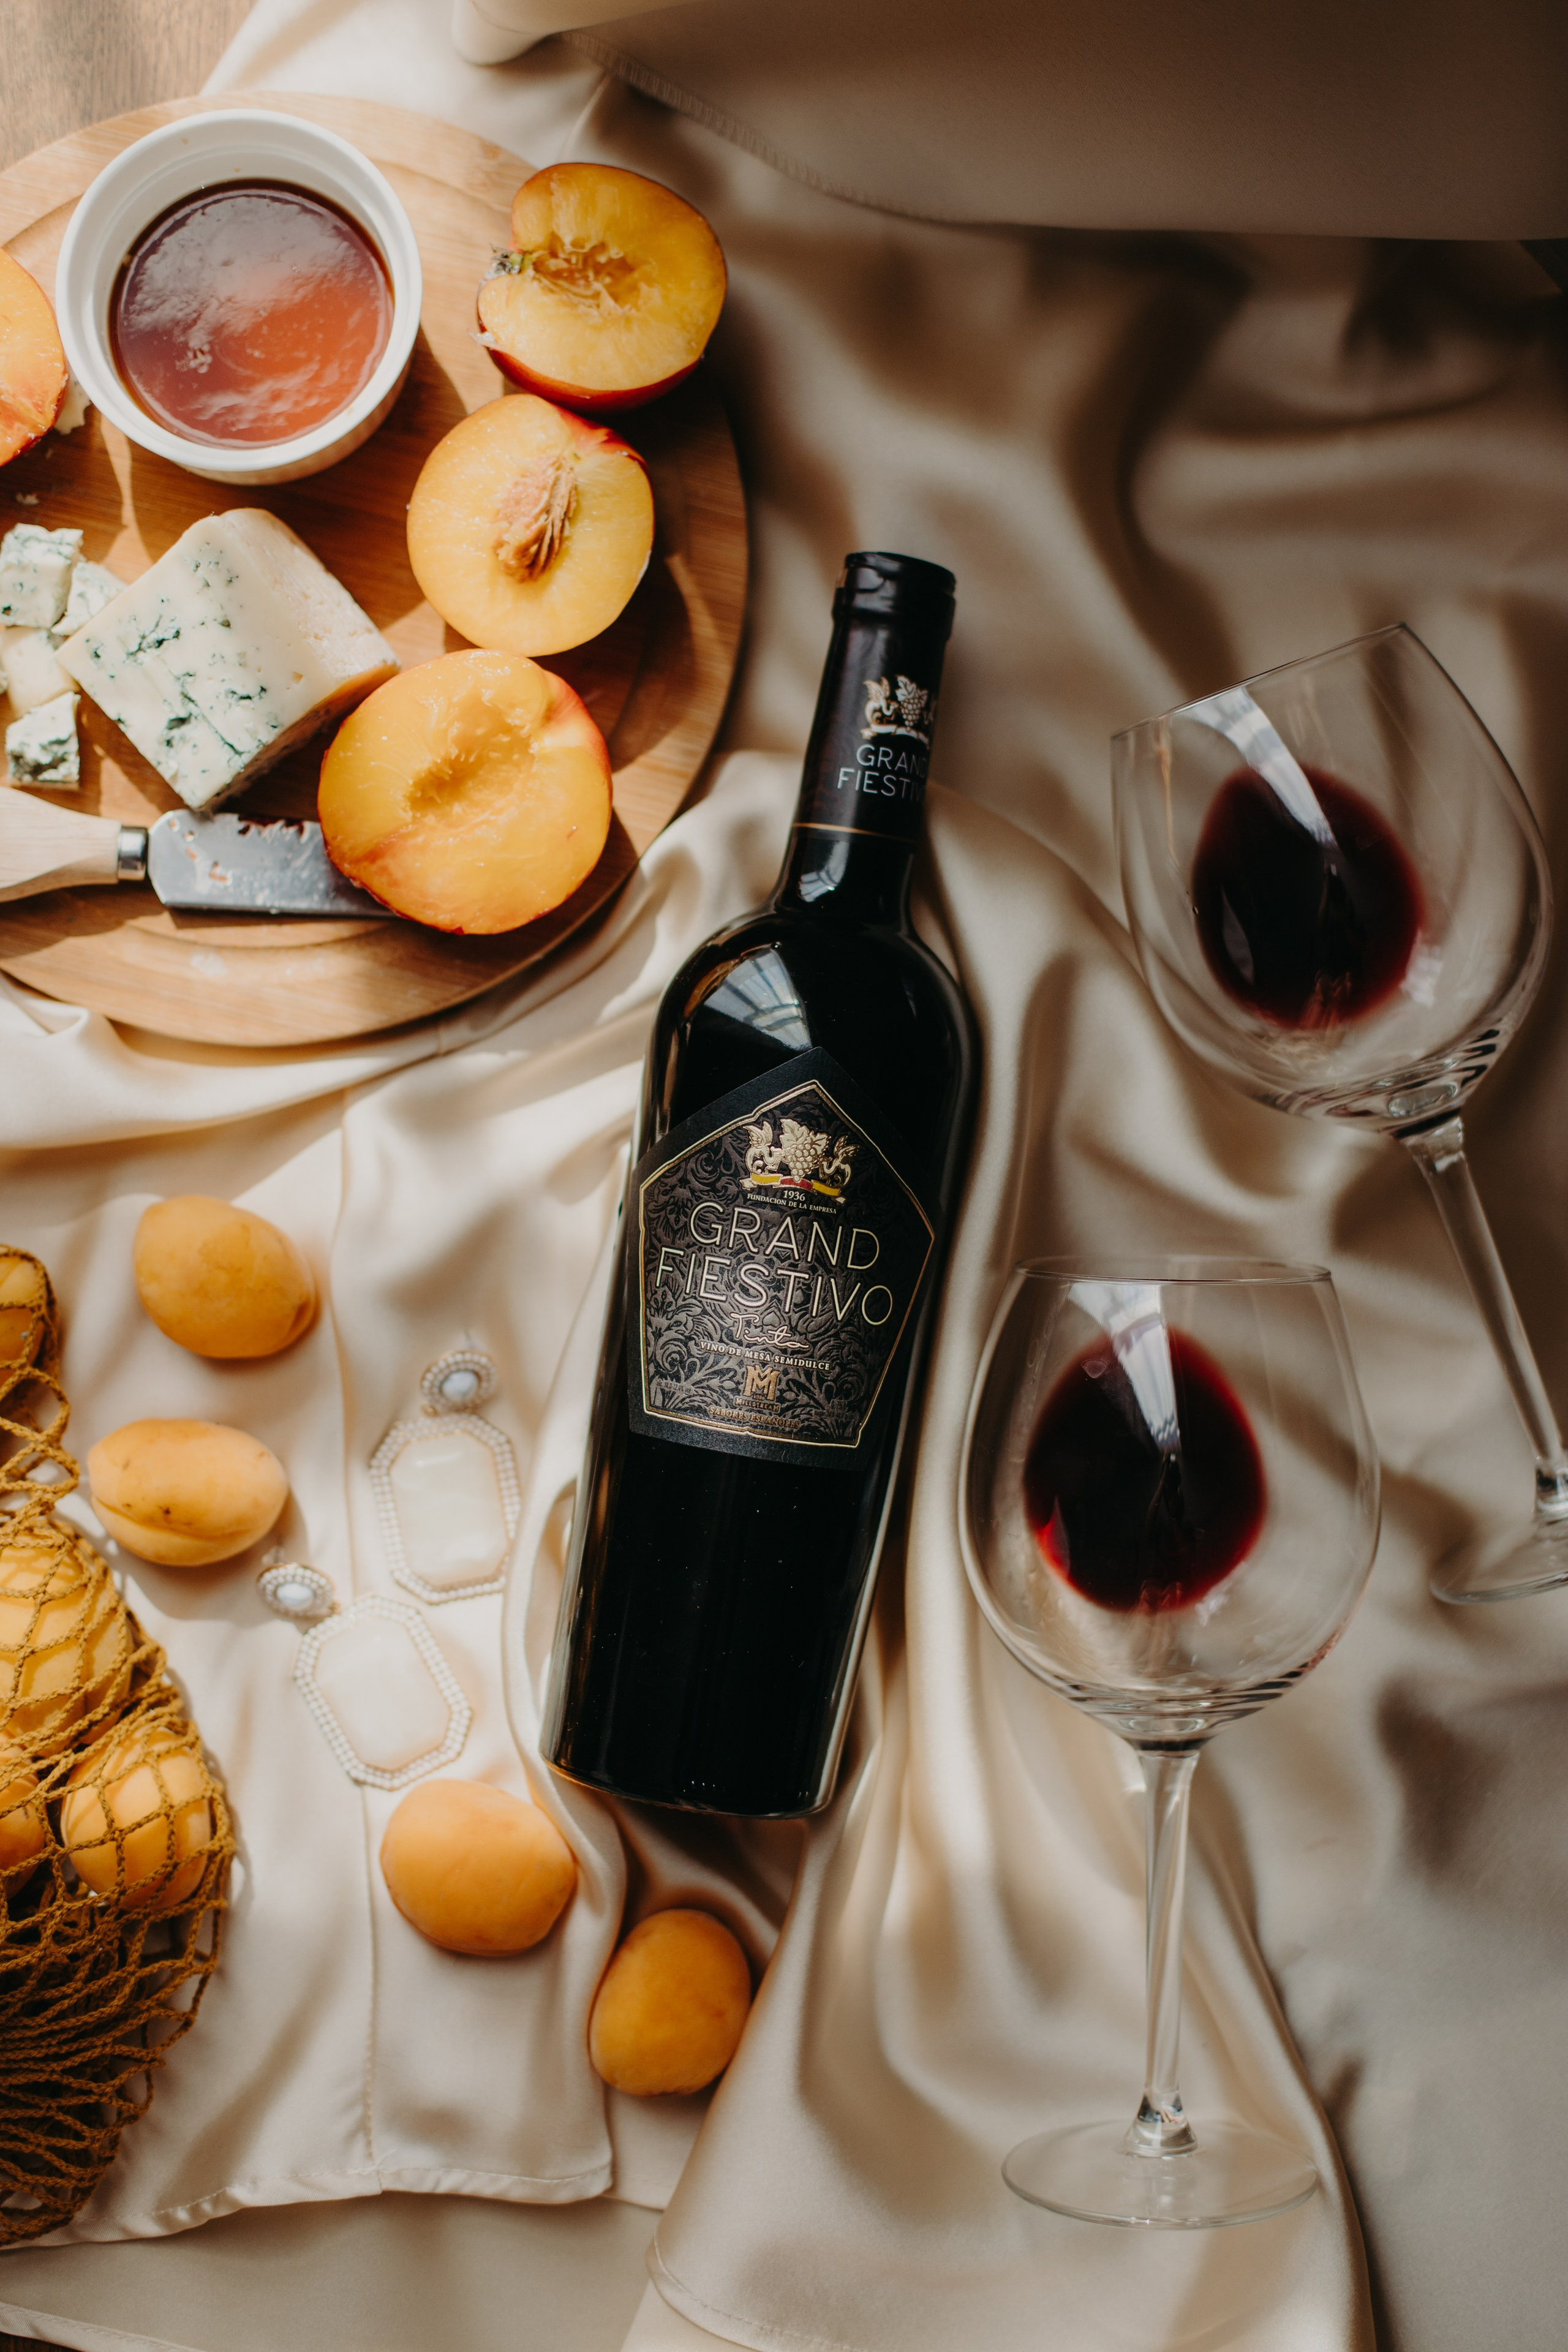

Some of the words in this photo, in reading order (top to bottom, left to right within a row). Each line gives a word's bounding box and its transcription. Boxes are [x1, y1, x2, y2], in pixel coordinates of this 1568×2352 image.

[747, 1193, 786, 1206] FUNDACION
[809, 1204, 837, 1214] EMPRESA
[783, 1189, 805, 1201] 1936
[690, 1202, 880, 1270] GRAND
[656, 1246, 893, 1325] FIESTIVO
[700, 1341, 725, 1354] VINO
[728, 1347, 742, 1356] DE
[744, 1349, 771, 1362] MESA
[774, 1355, 831, 1371] SEMIDULCE
[709, 1406, 748, 1420] SABORES
